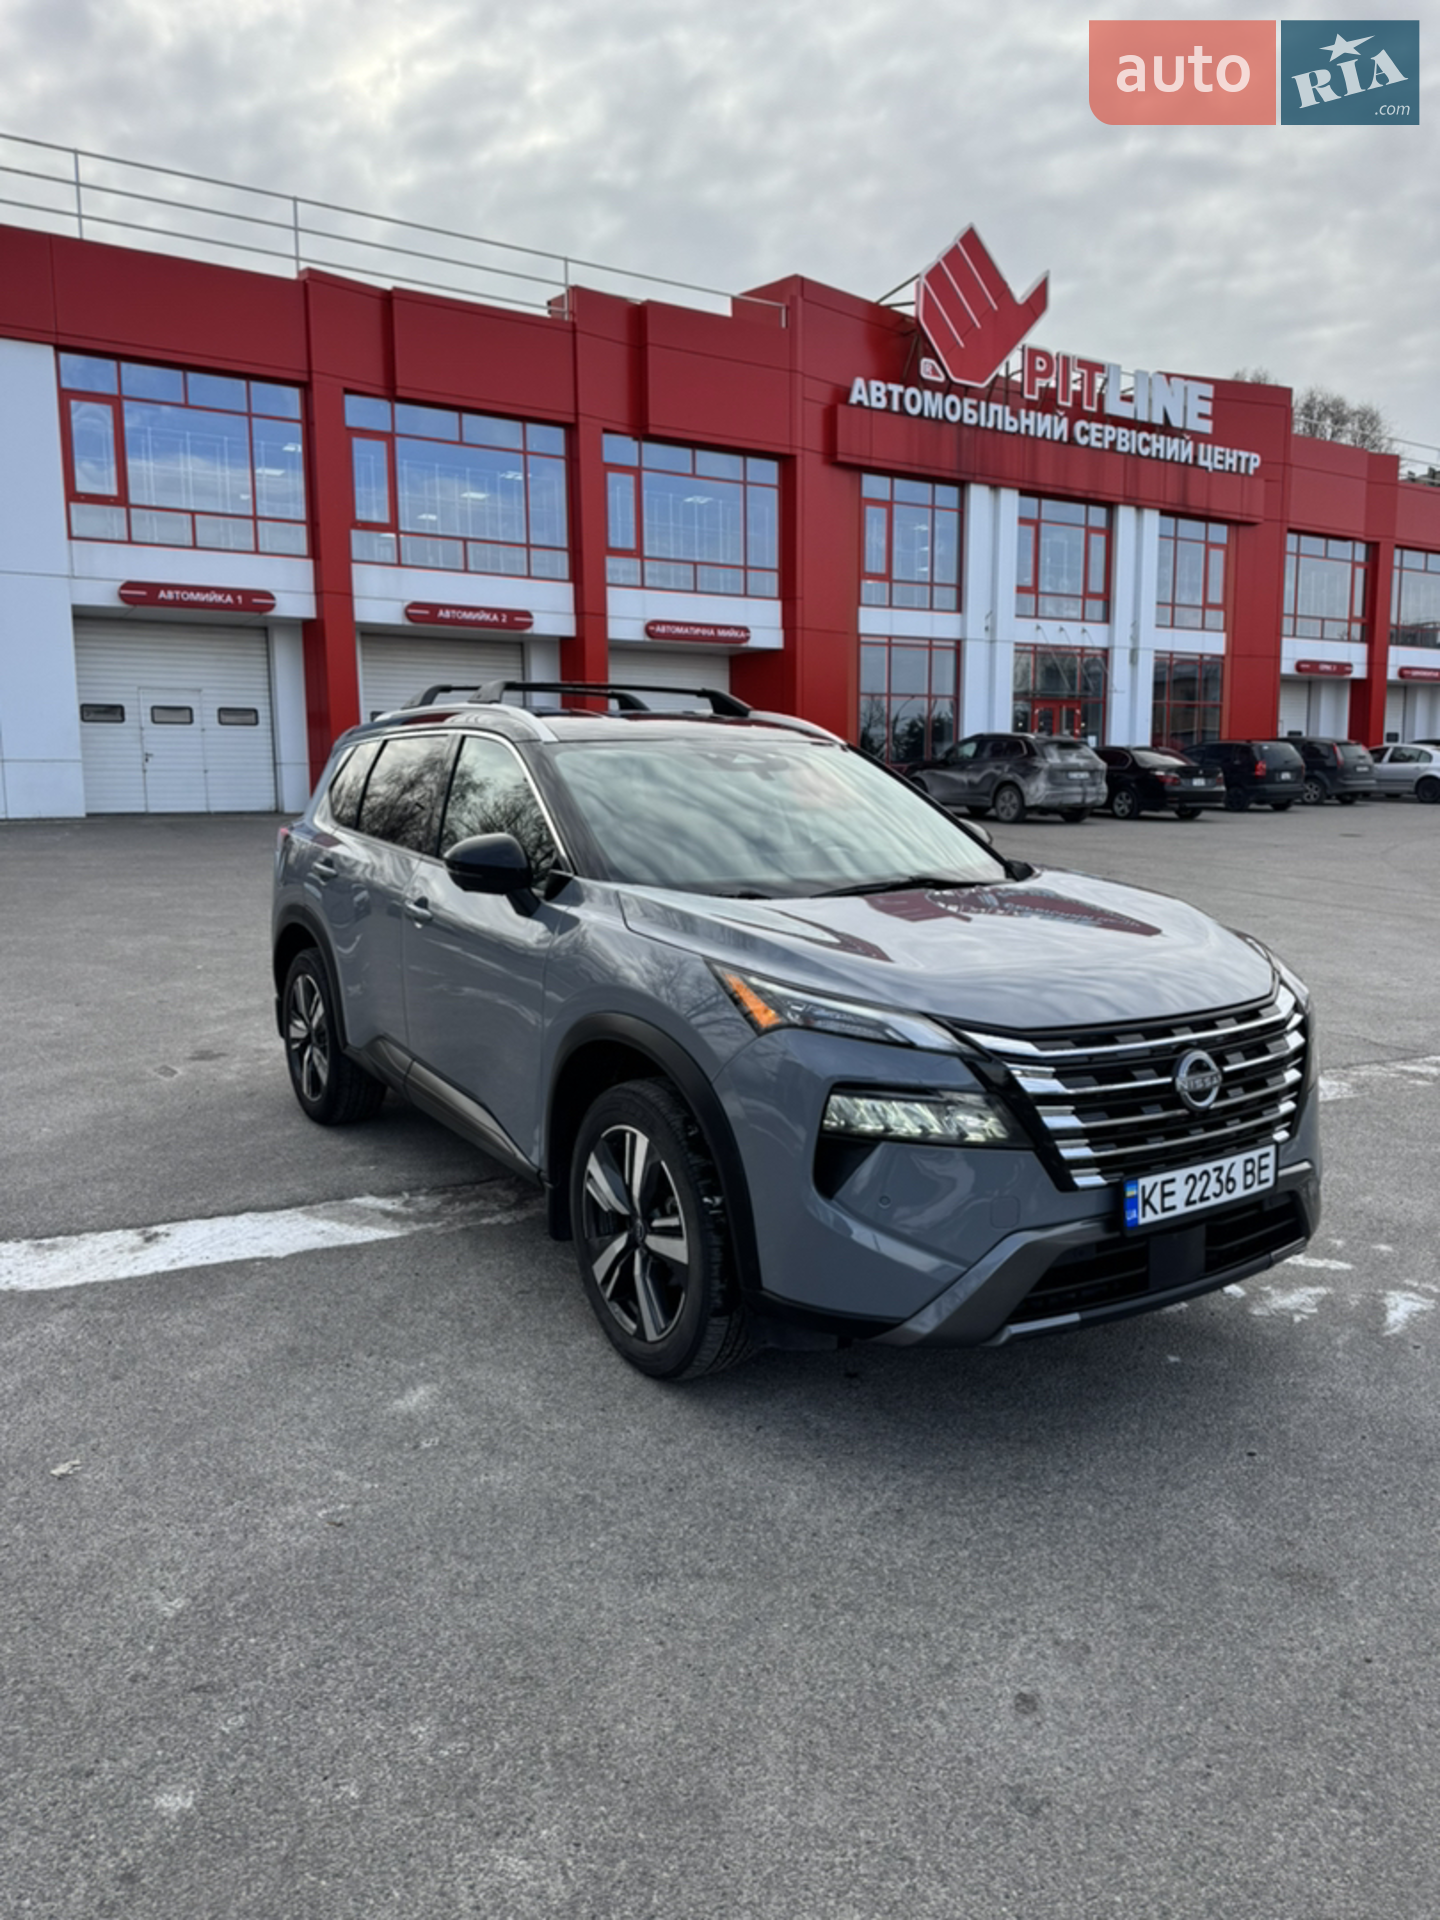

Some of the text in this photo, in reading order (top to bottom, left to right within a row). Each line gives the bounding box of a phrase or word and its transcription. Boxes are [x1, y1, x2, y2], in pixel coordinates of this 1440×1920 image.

[1022, 344, 1214, 435] PITLINE
[849, 376, 1262, 476] АВТОМОБІЛЬНИЙ СЕРВІСНИЙ ЦЕНТР
[158, 589, 243, 605] АВТОМИЙКА 1
[437, 608, 508, 623] АВТОМИЙКА 2
[1141, 1151, 1271, 1219] KE 2236 BE
